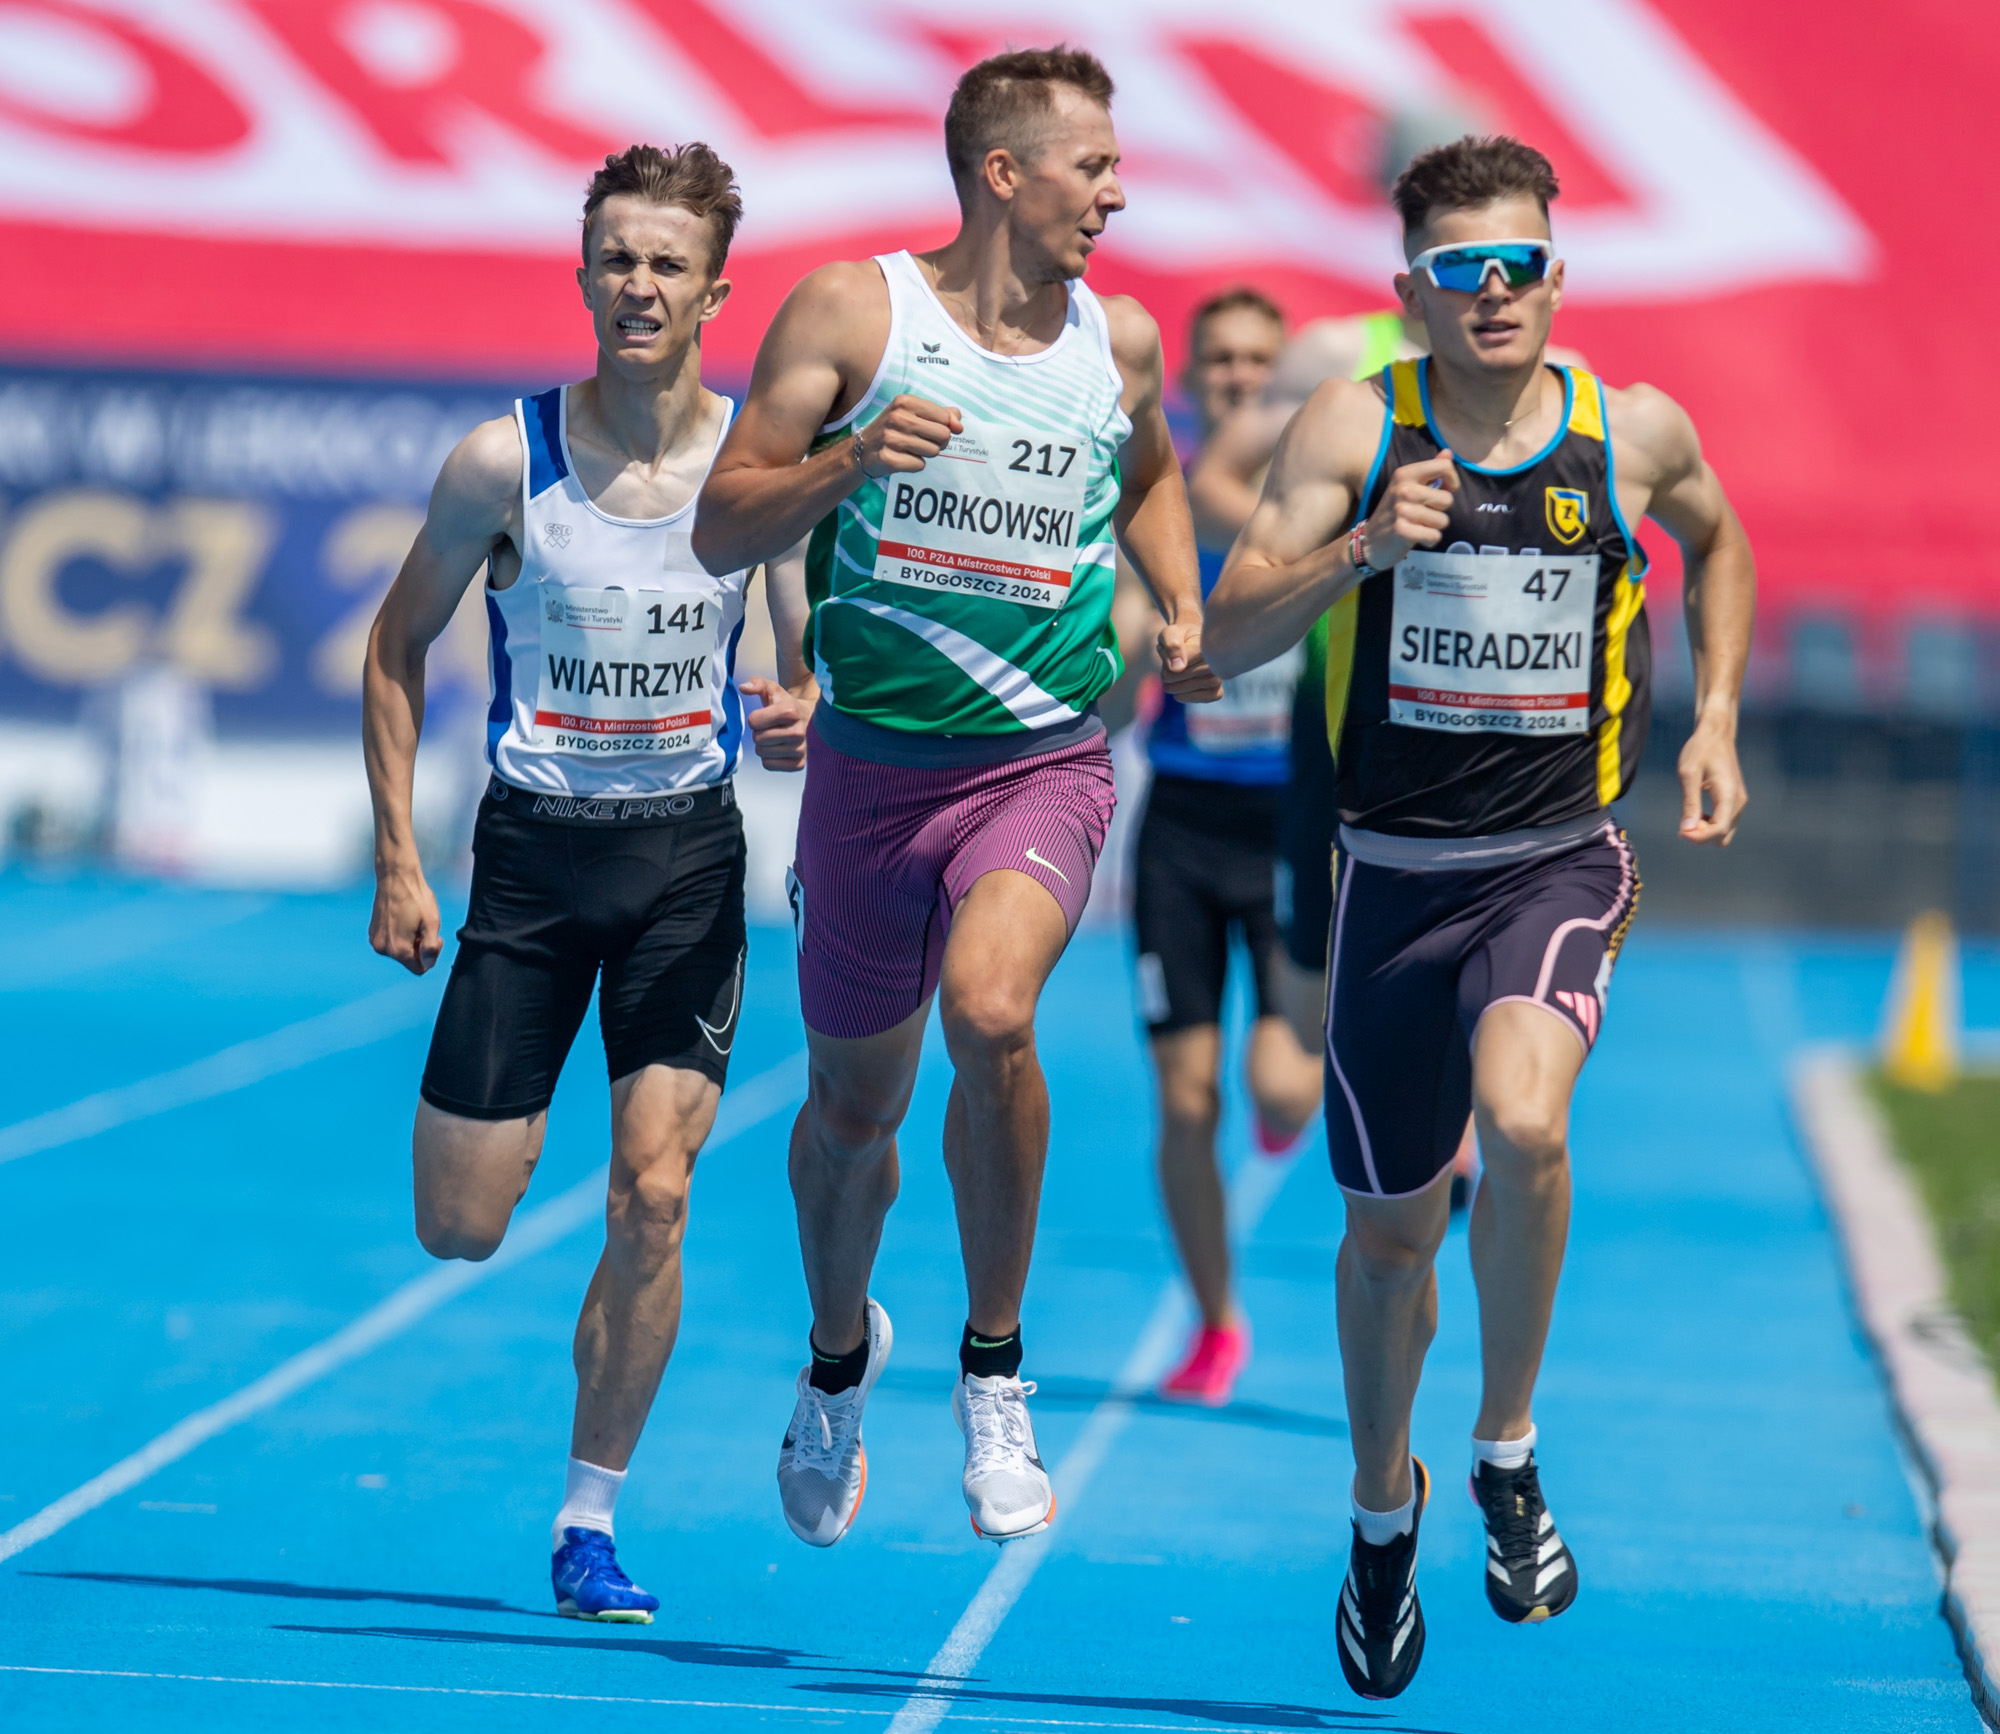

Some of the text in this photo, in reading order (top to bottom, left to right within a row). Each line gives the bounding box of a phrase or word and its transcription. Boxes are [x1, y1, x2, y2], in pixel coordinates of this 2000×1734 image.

[916, 355, 949, 366] erima
[1008, 439, 1077, 478] 217
[893, 483, 1074, 547] BORKOWSKI
[907, 547, 1051, 580] 100. PZLA Mistrzostwa Polski
[900, 566, 1051, 602] BYDGOSZCZ 2024
[1522, 569, 1572, 602] 47
[565, 603, 609, 614] Ministerstwo
[592, 615, 623, 624] Turystyki
[646, 601, 705, 634] 141
[1400, 624, 1582, 670] SIERADZKI
[548, 653, 707, 698] WIATRZYK
[1417, 689, 1569, 707] 100. PZLA Mistrzostwa Polski
[560, 715, 690, 732] 100. PZLA Mistrzostwa Polski
[1415, 708, 1566, 729] BYDGOSZCZ 2024
[556, 733, 691, 751] BYDGOSZCZ 2024
[532, 795, 619, 820] NIKE
[620, 794, 695, 820] PRO
